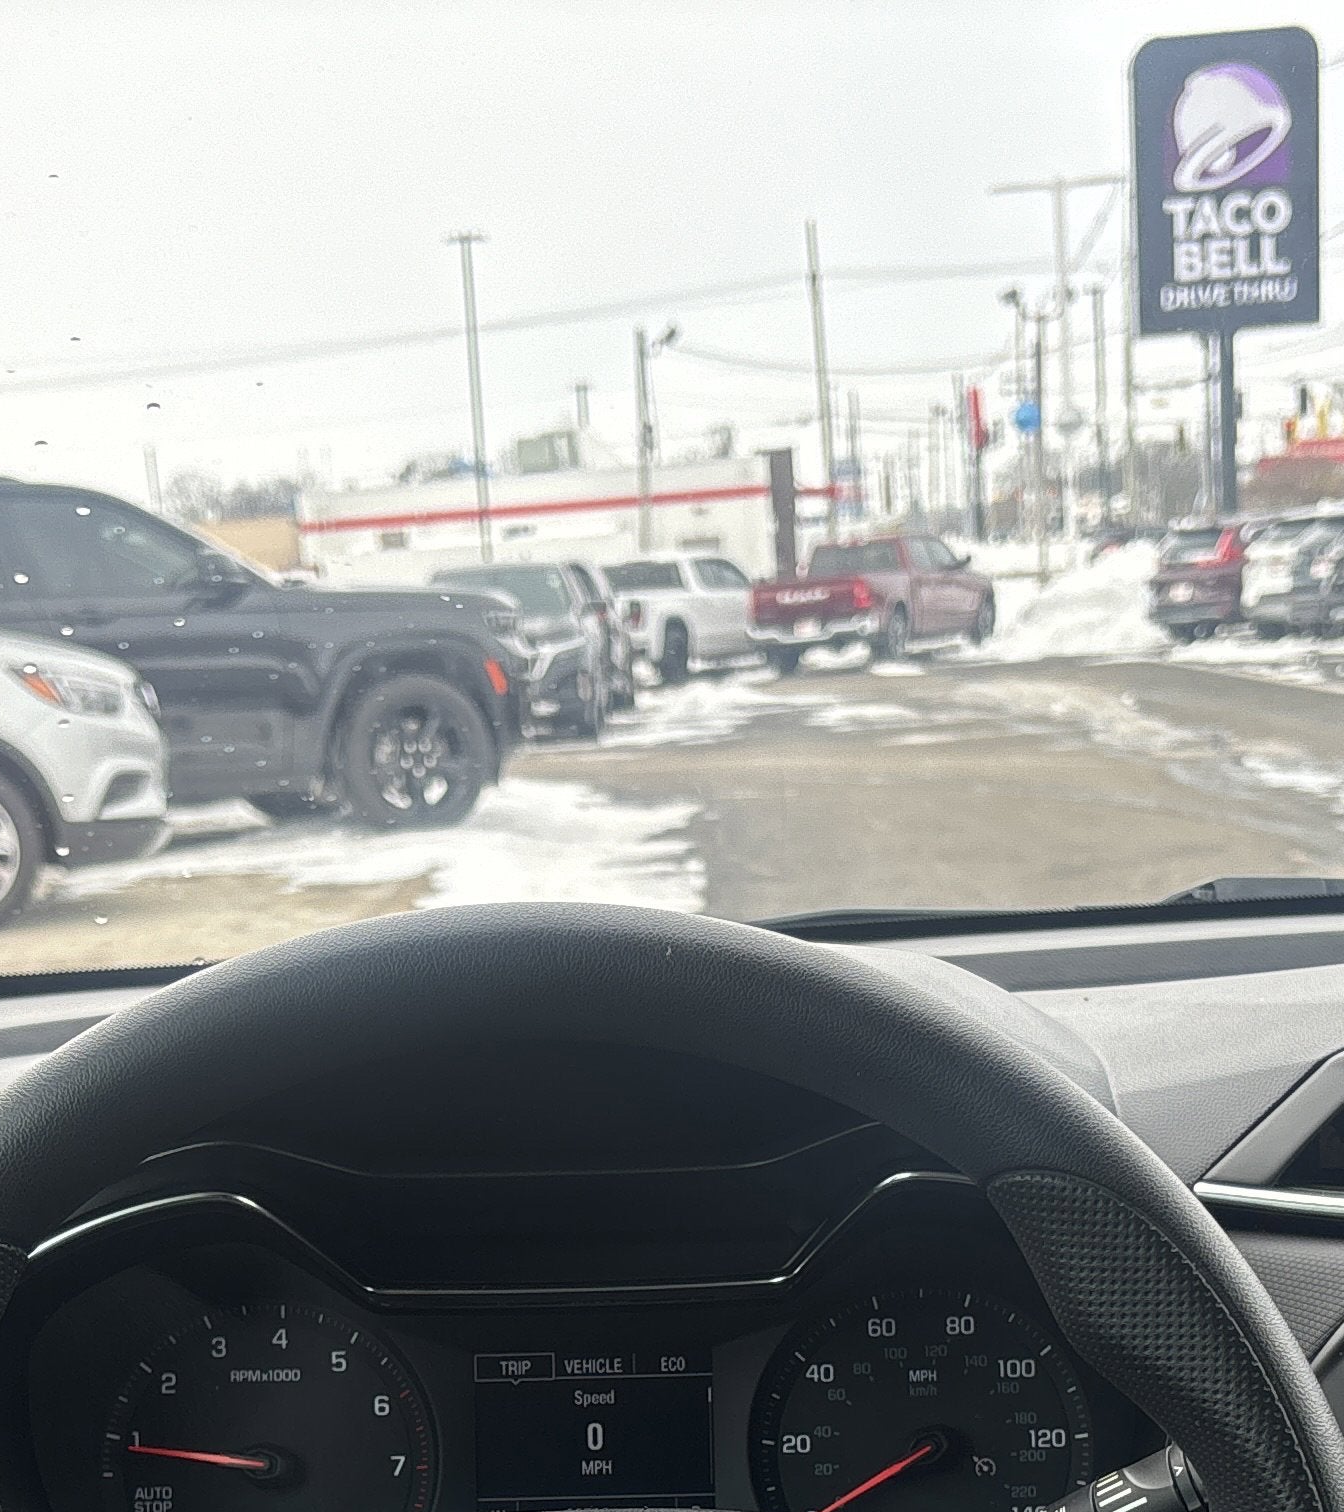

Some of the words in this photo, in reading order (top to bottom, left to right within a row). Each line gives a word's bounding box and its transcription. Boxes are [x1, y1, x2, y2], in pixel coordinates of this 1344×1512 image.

[1162, 189, 1292, 240] TACO
[1173, 234, 1292, 282] BELL
[1160, 281, 1233, 312] DRIVE
[1233, 275, 1298, 305] THRU
[867, 1318, 896, 1337] 60
[946, 1316, 975, 1335] 80
[211, 1336, 227, 1358] 3
[271, 1328, 288, 1350] 4
[331, 1350, 347, 1372] 5
[883, 1347, 908, 1360] 100
[924, 1344, 947, 1357] 120
[499, 1360, 532, 1376] TRIP
[564, 1357, 623, 1374] VEHICLE
[660, 1356, 686, 1372] ECO
[853, 1362, 871, 1376] 80
[964, 1355, 988, 1368] 140
[997, 1359, 1036, 1378] 100
[805, 1363, 834, 1383] 40
[909, 1370, 937, 1383] MPH
[161, 1372, 177, 1394] 2
[909, 1384, 937, 1397] km/h
[574, 1389, 615, 1408] Speed
[827, 1388, 846, 1401] 60
[374, 1395, 390, 1417] 6
[1014, 1411, 1038, 1425] 180
[586, 1422, 604, 1451] 0
[814, 1425, 832, 1438] 40
[1028, 1429, 1066, 1448] 120
[782, 1434, 811, 1454] 20
[1019, 1449, 1046, 1462] 200
[390, 1455, 406, 1477] 7
[581, 1459, 613, 1475] MPH
[814, 1463, 833, 1476] 20
[134, 1486, 173, 1500] AUTO
[1010, 1485, 1037, 1498] 220
